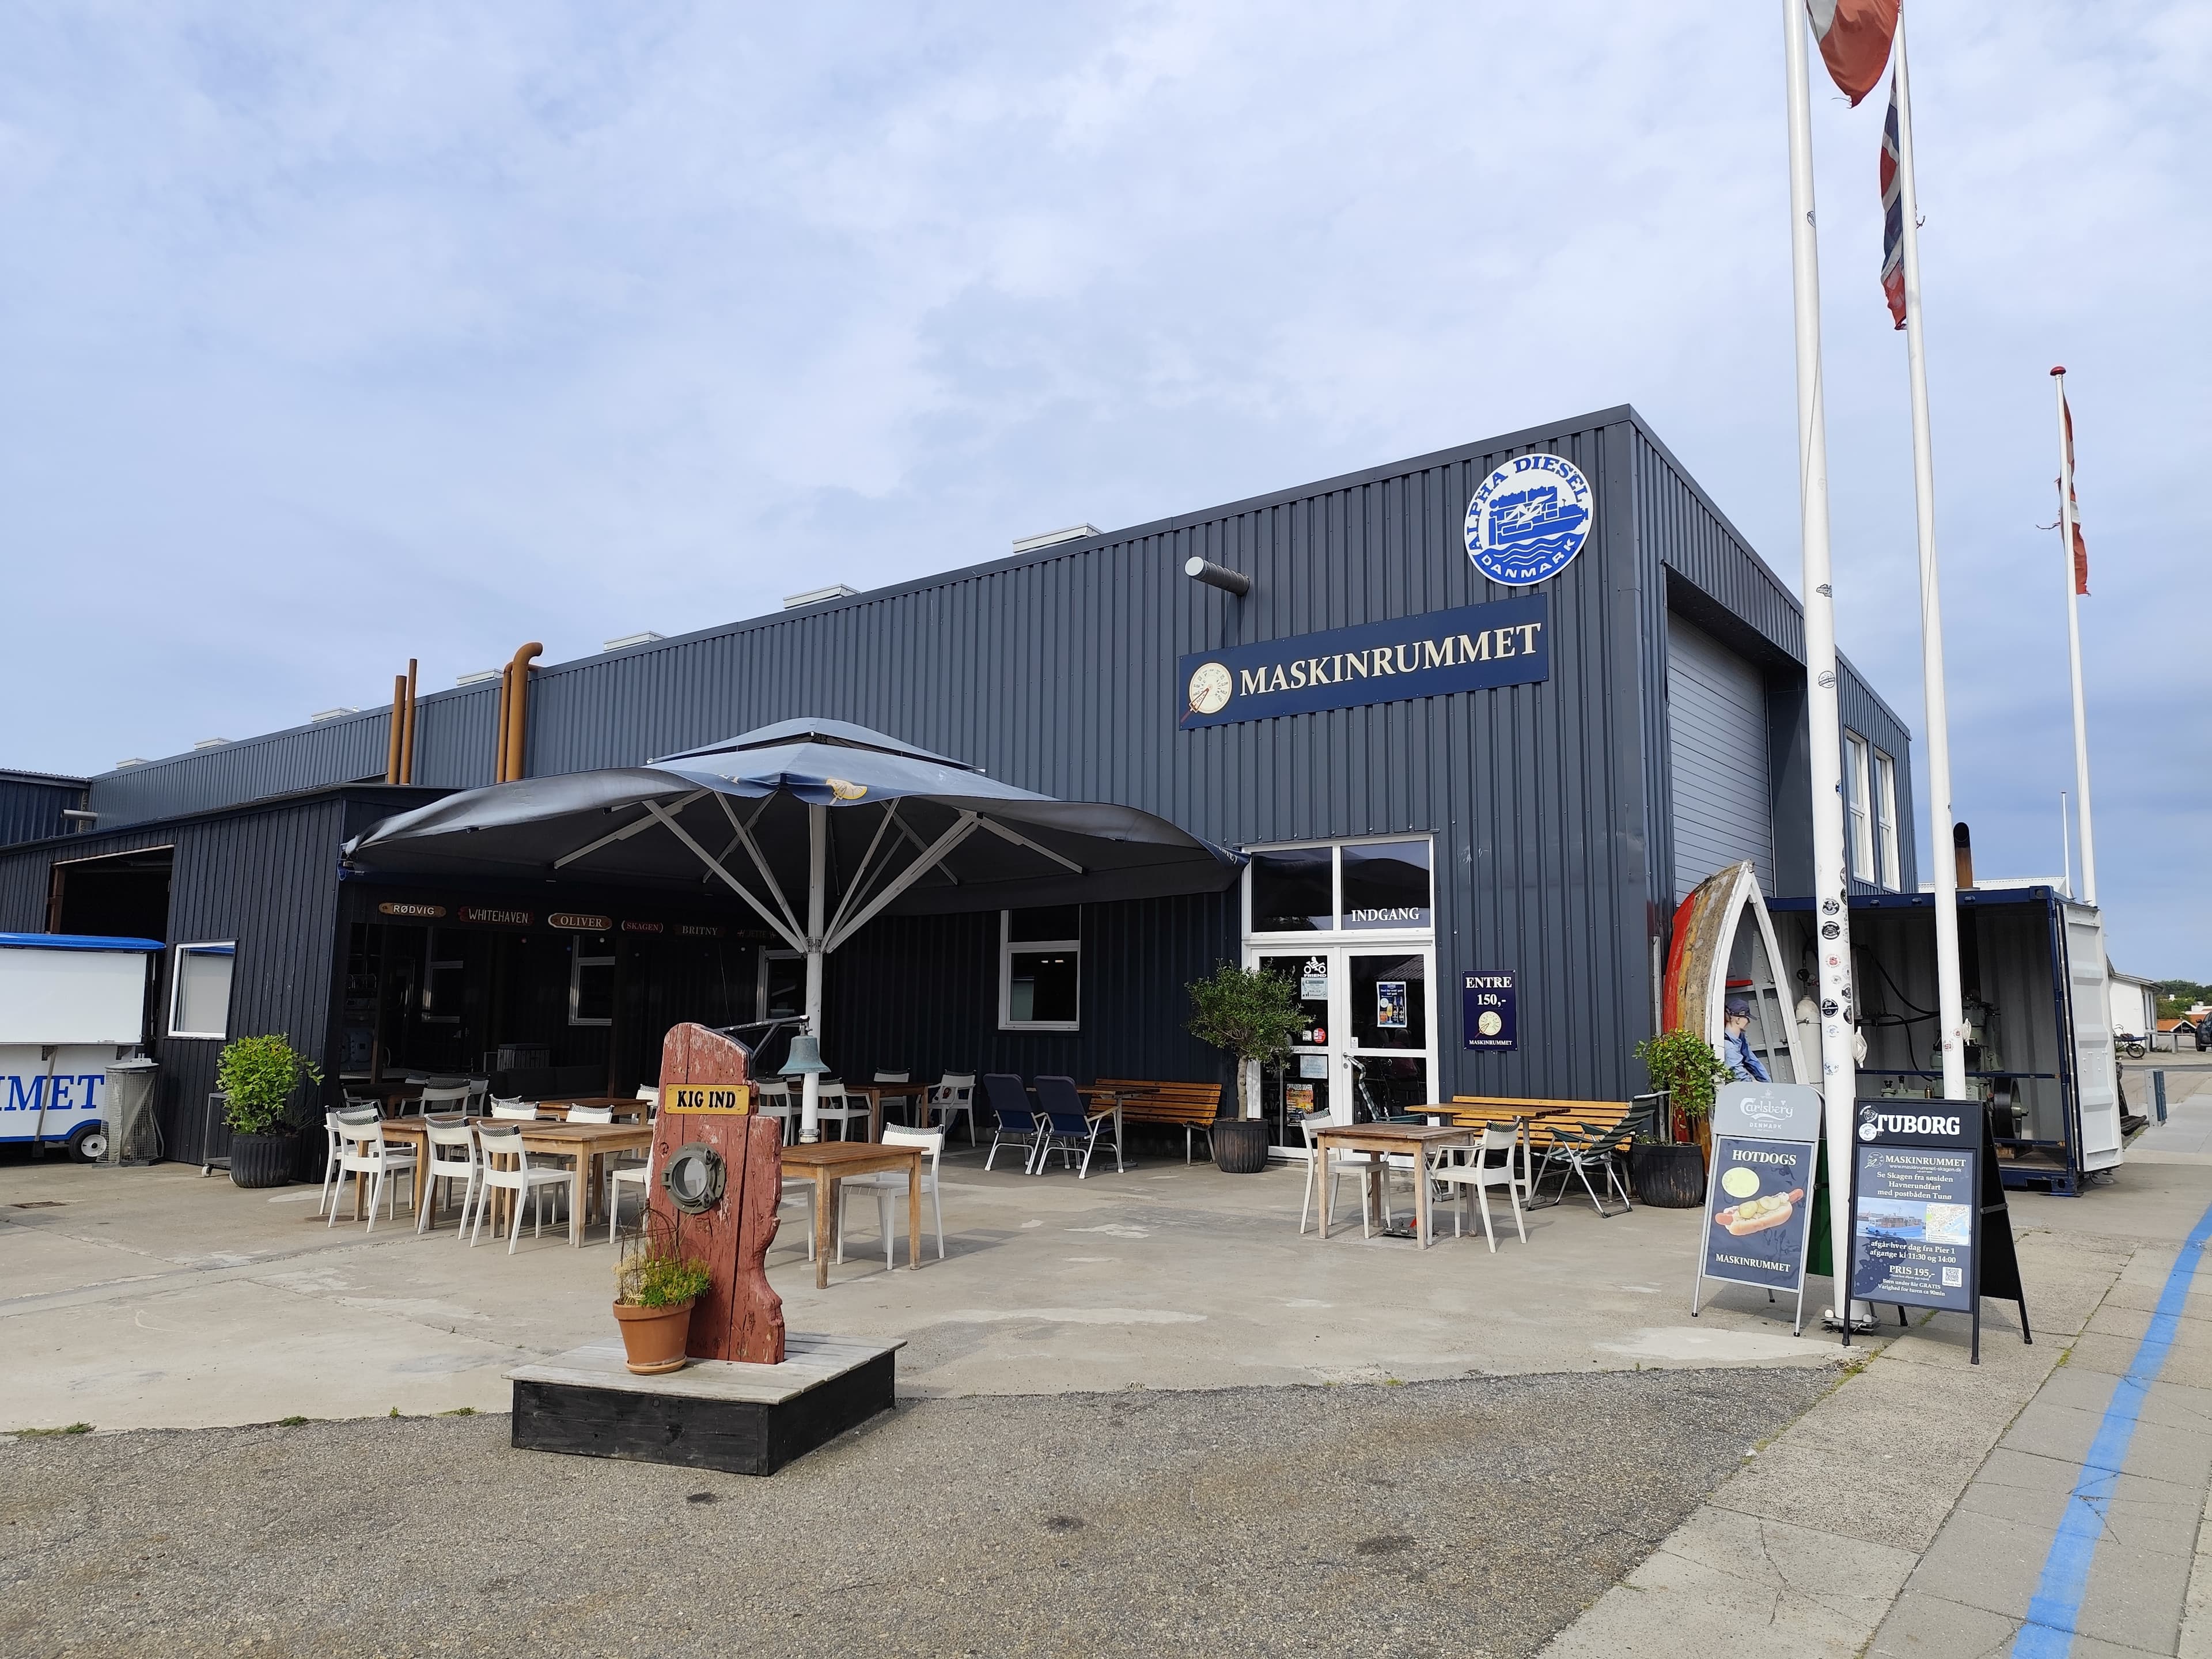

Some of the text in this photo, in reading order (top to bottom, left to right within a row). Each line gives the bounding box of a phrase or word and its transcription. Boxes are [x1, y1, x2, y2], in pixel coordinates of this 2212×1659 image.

[1467, 456, 1588, 552] ALPHA DIESEL
[1481, 538, 1576, 579] DANMARK
[1239, 622, 1542, 696] MASKINRUMMET
[393, 904, 435, 915] RØDVIG
[468, 908, 529, 923] WHITEHAVEN
[1351, 907, 1420, 922] INDGANG
[560, 915, 603, 928] OLIVER
[681, 926, 718, 935] BRITNY
[1465, 976, 1512, 988] ENTRE
[1477, 994, 1506, 1007] 150,-
[0, 1075, 105, 1111] MET
[677, 1090, 736, 1108] KIG IND
[1740, 1097, 1794, 1119] Carlsberg
[1876, 1114, 1960, 1135] TUBORG
[1732, 1150, 1797, 1165] HOTDOGS
[1885, 1155, 1966, 1167] MASKINRUMMET
[1887, 1172, 1913, 1181] Skagen
[1926, 1174, 1954, 1182] søsiden
[1889, 1181, 1941, 1191] Havnerundfart
[1894, 1191, 1931, 1199] postbåden
[1870, 1240, 1889, 1249] afgår
[1908, 1244, 1922, 1252] dag
[1935, 1246, 1950, 1254] Pier
[1870, 1249, 1897, 1259] afgange
[1715, 1253, 1791, 1272] MASKINRUMMET
[1889, 1265, 1936, 1278] PRIS 195,-
